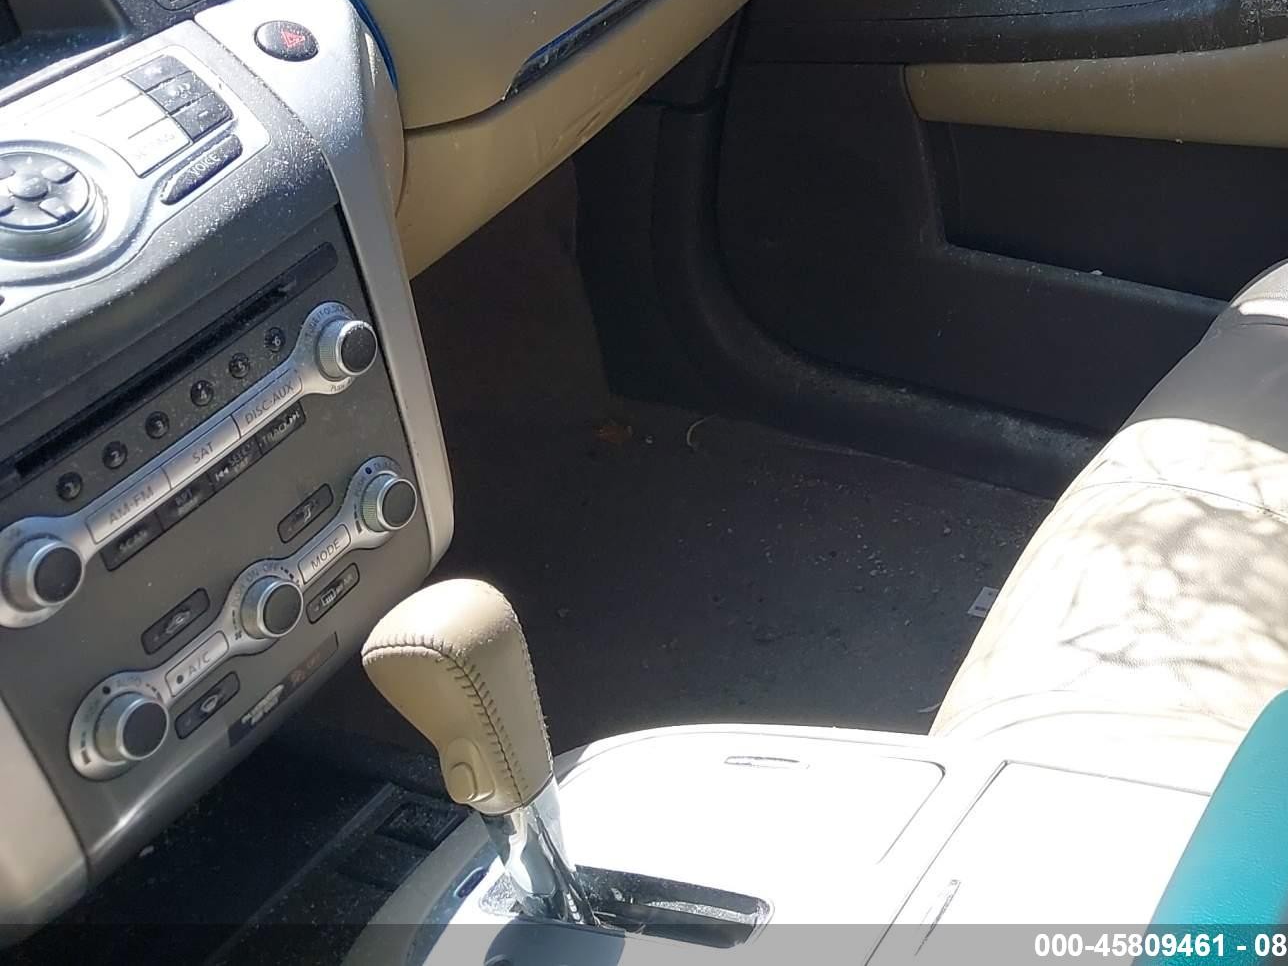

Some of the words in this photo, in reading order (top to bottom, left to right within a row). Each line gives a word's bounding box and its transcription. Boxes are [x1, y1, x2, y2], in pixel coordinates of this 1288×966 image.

[189, 153, 221, 176] VOICE
[111, 450, 121, 462] 2
[191, 441, 215, 464] SAT
[310, 537, 342, 570] MODE
[187, 650, 212, 677] A/C
